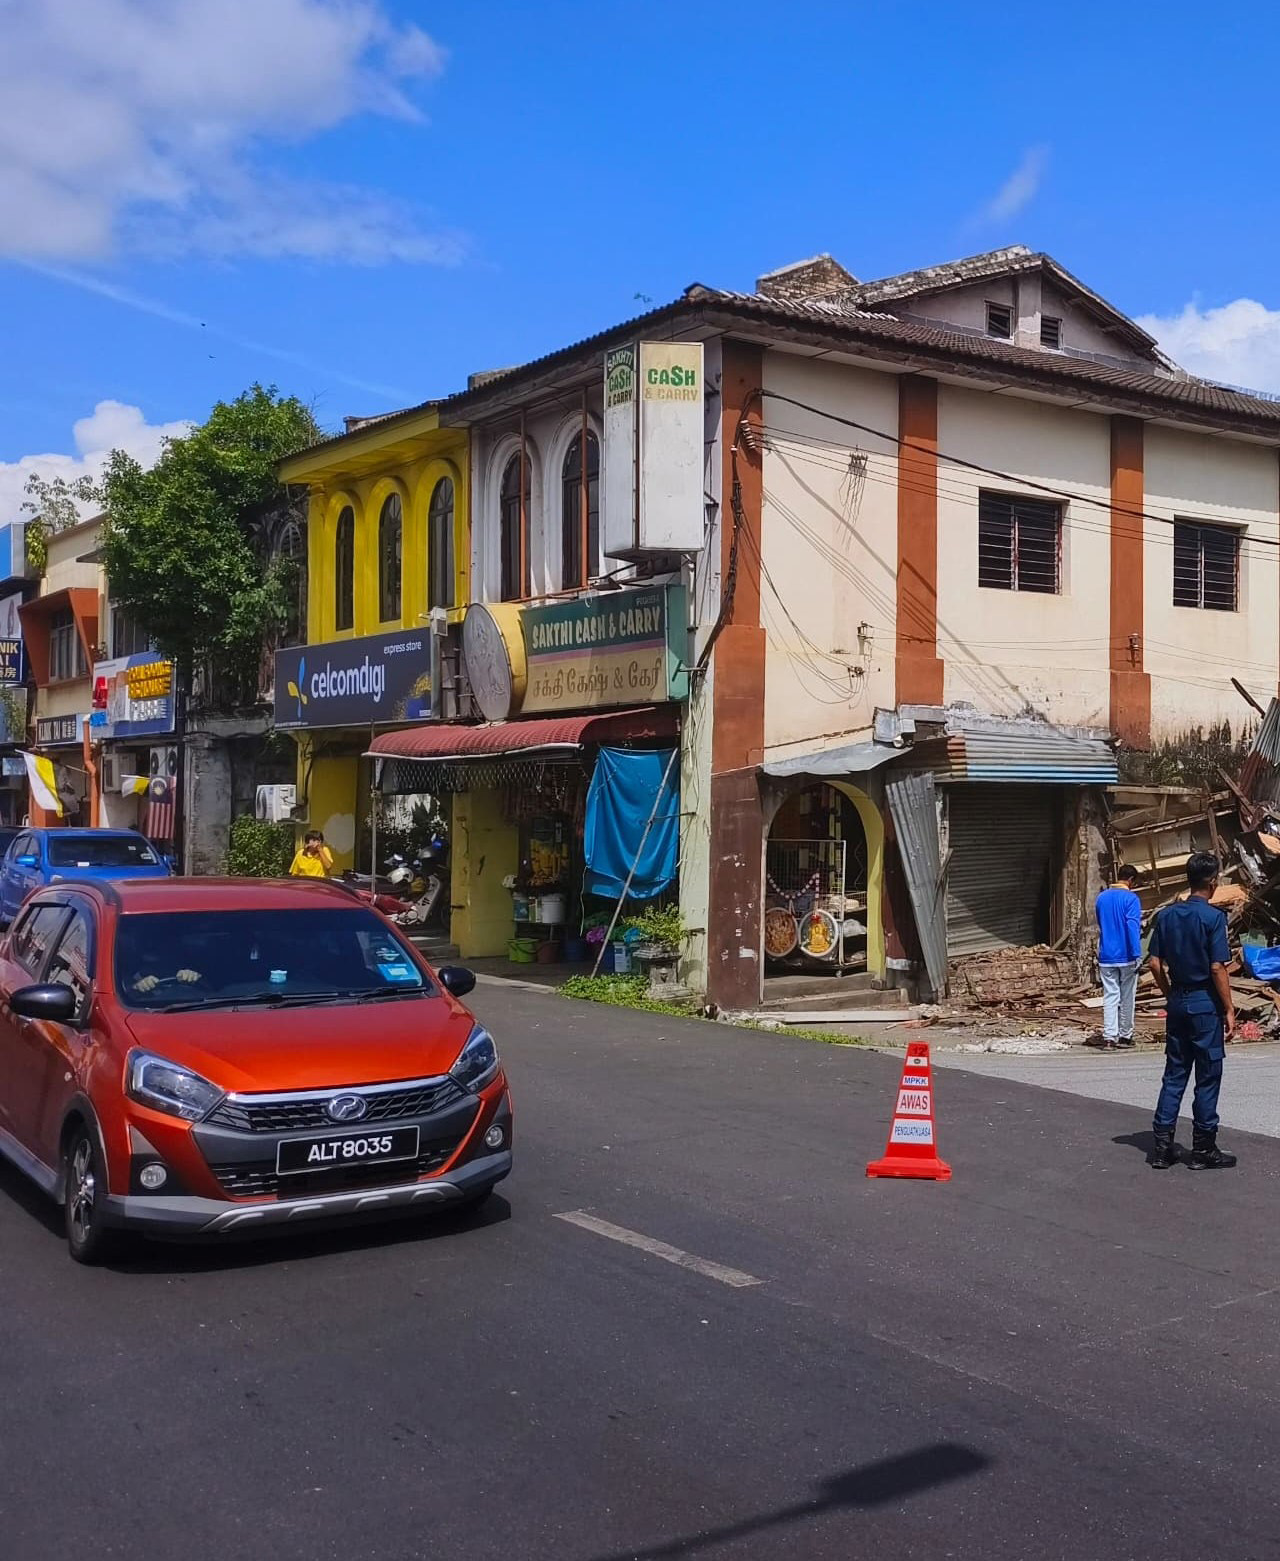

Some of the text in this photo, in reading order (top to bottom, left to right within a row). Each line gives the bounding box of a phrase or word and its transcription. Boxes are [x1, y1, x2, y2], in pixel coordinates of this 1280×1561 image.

[608, 368, 632, 392] CASH
[647, 365, 696, 387] CASH
[613, 389, 633, 405] CARRY
[658, 388, 698, 401] CARRY
[532, 606, 661, 649] SAKTHI CASH & CARRY
[383, 641, 422, 656] express store
[311, 655, 385, 703] celcomdigi
[613, 666, 624, 690] &
[904, 1077, 928, 1085] MPKK
[900, 1094, 928, 1110] AWAS
[895, 1125, 931, 1137] PENGUATKUASA
[307, 1135, 393, 1162] ALT8035
